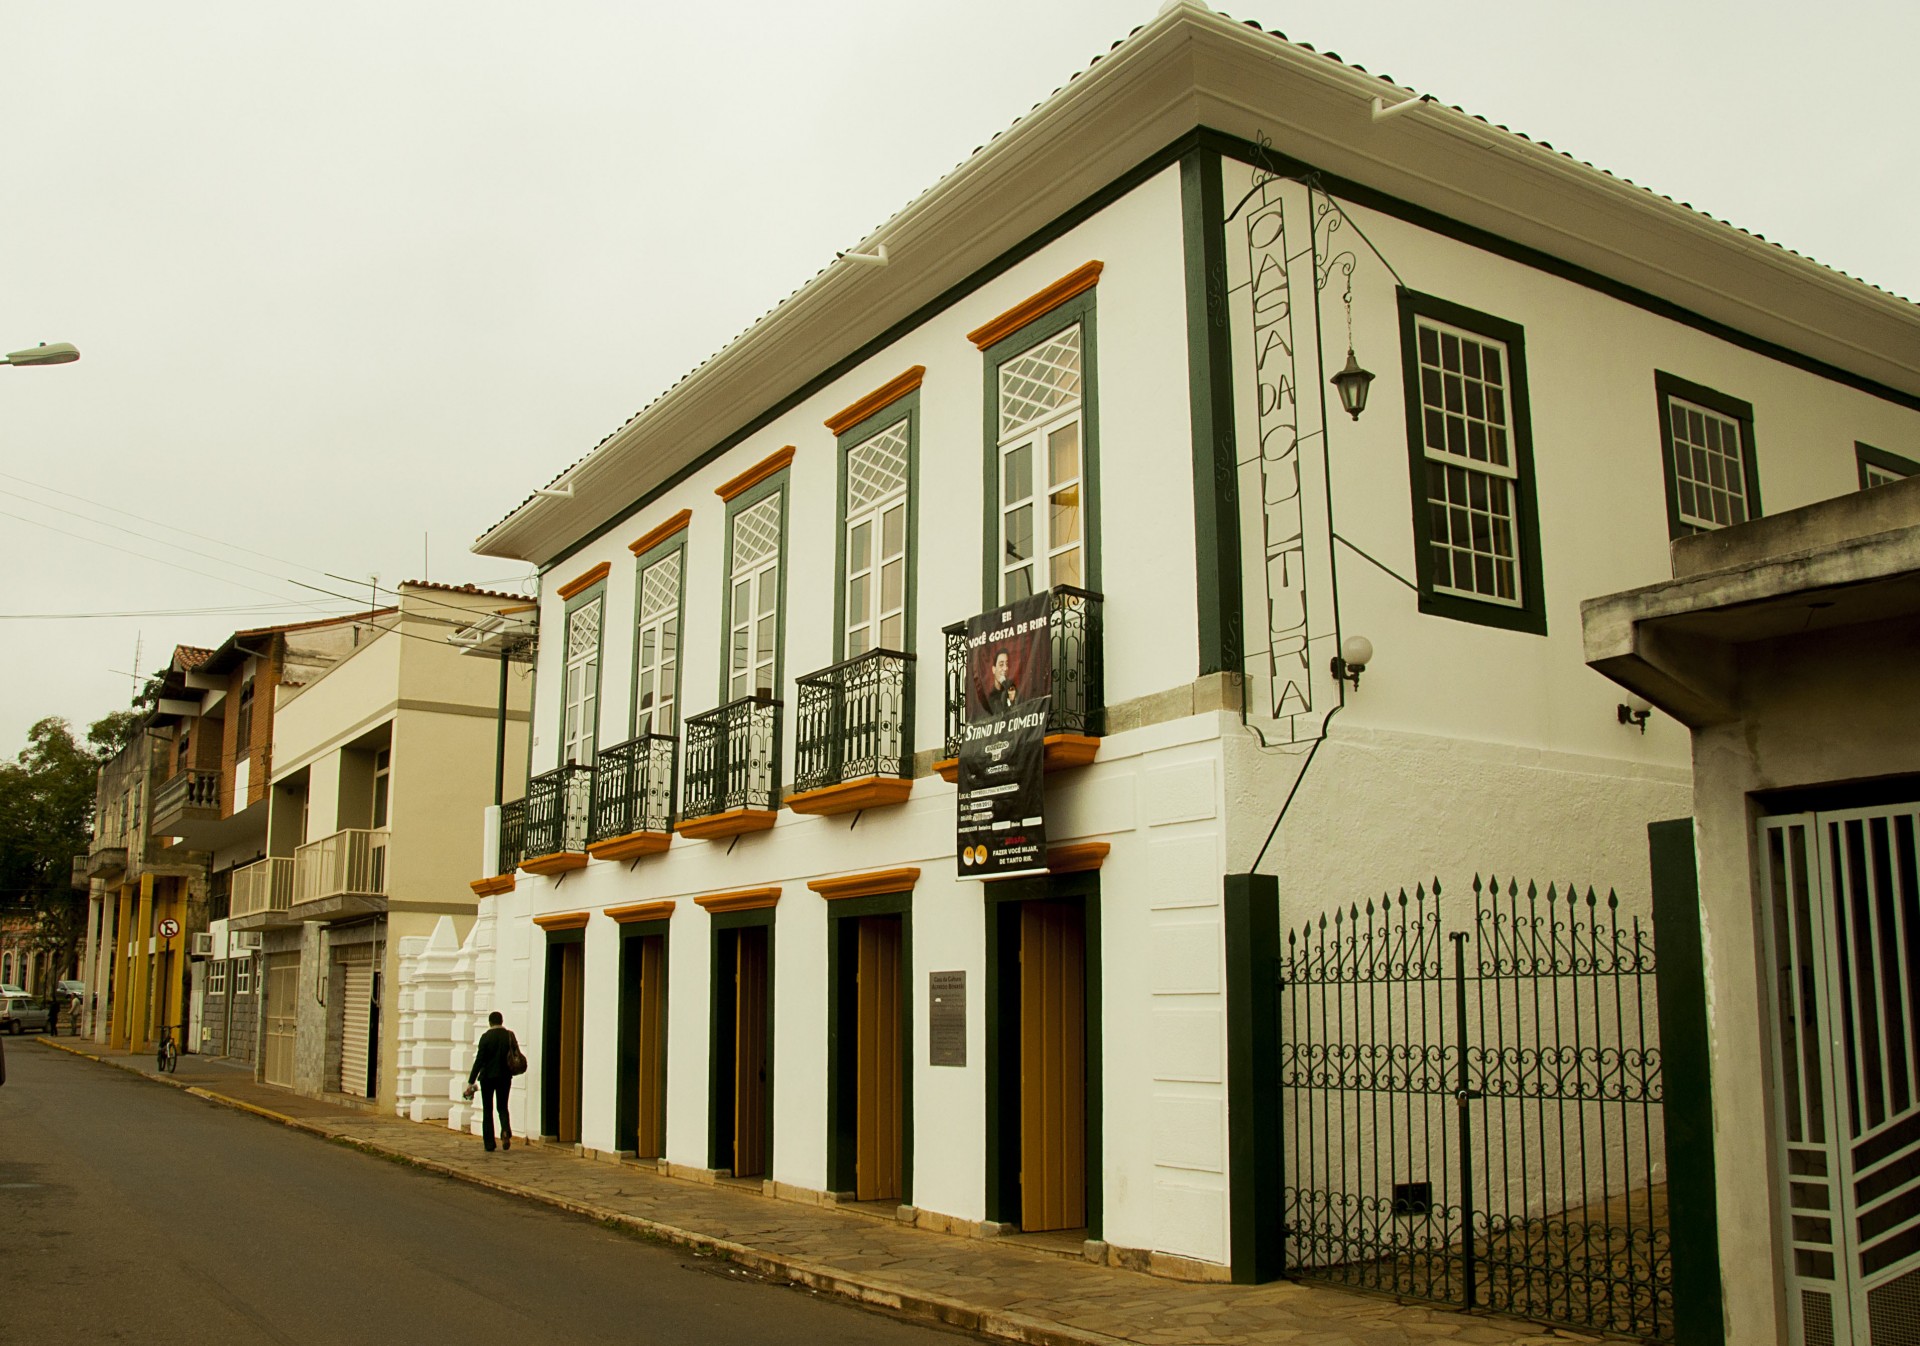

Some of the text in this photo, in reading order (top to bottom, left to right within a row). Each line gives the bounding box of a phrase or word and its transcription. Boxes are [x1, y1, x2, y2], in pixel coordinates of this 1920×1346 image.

[1249, 211, 1313, 719] CASA DA CULTURA
[968, 631, 987, 649] VOCÊ
[988, 626, 1015, 643] GOSTA
[1016, 621, 1028, 635] DE
[965, 712, 1045, 742] STAND UP COMEDY
[992, 849, 1008, 857] FAZER
[1006, 856, 1023, 864] TANTO
